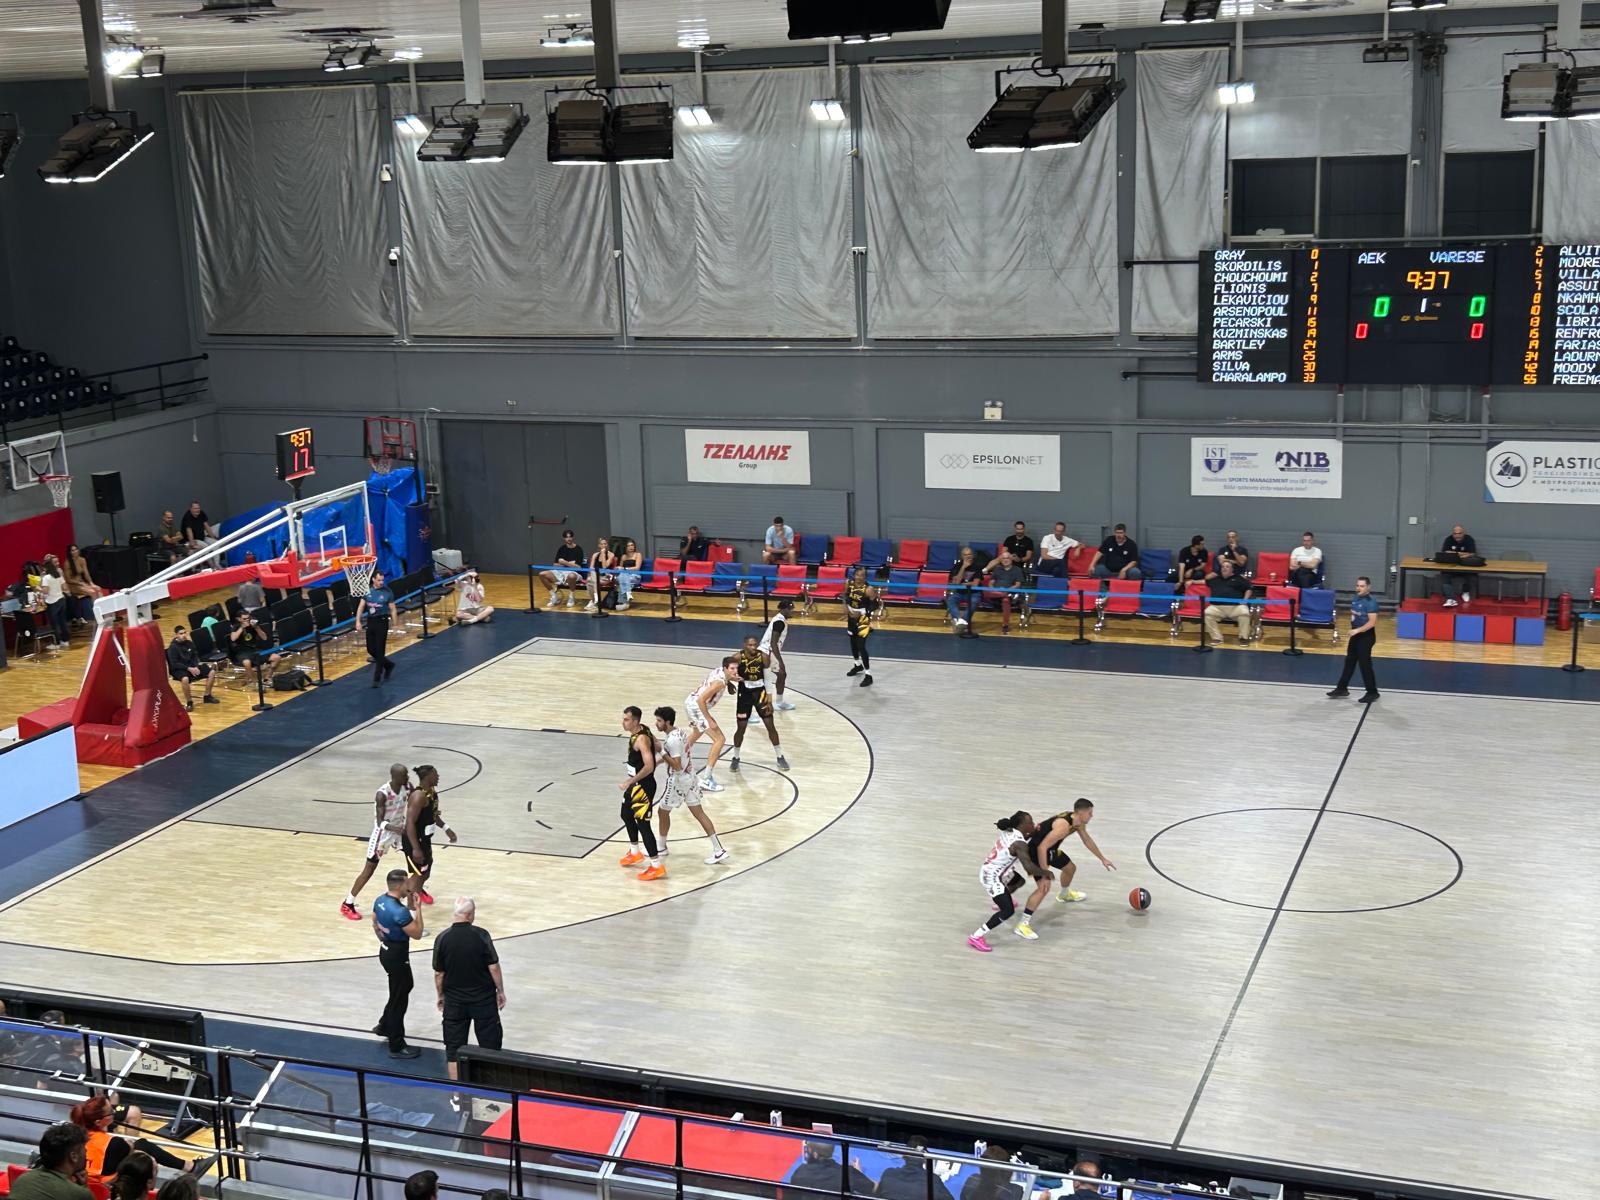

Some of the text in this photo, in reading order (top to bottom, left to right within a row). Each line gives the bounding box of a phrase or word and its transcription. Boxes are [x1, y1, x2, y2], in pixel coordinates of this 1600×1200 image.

[1214, 249, 1319, 260] GRAY 0
[1535, 245, 1544, 256] 2
[1357, 252, 1387, 264] AEK
[1429, 251, 1486, 263] VARESE
[1535, 257, 1600, 268] 4 MOORE
[1214, 261, 1282, 271] SKORDILIS
[1214, 272, 1318, 283] CHOUCHOUMI 2
[1534, 269, 1600, 280] 5 VILLA
[1406, 271, 1450, 291] 9:37
[1535, 281, 1599, 291] 7 ASSUI
[1214, 283, 1318, 294] FLIONIS 7
[1214, 294, 1318, 306] LEKAVICIOU 9
[1557, 293, 1600, 303] NKAMH
[1213, 306, 1287, 316] ARSENOPOUL
[1373, 295, 1391, 318] 0
[1469, 295, 1486, 318] 0
[1556, 304, 1599, 315] SCOLA
[1213, 317, 1272, 327] PECARSKI
[1213, 328, 1288, 338] KUZMINSKAS
[1355, 323, 1368, 339] 0
[1470, 322, 1484, 339] 0
[1213, 339, 1265, 349] BARTLEY
[1213, 350, 1243, 360] ARMS
[1213, 361, 1250, 372] SILVA
[1553, 363, 1596, 373] MOODY
[1213, 372, 1286, 382] CHARALAMPO
[290, 431, 311, 447] 9:37
[1205, 447, 1225, 457] IST
[294, 448, 309, 472] 17
[738, 462, 758, 470] Group
